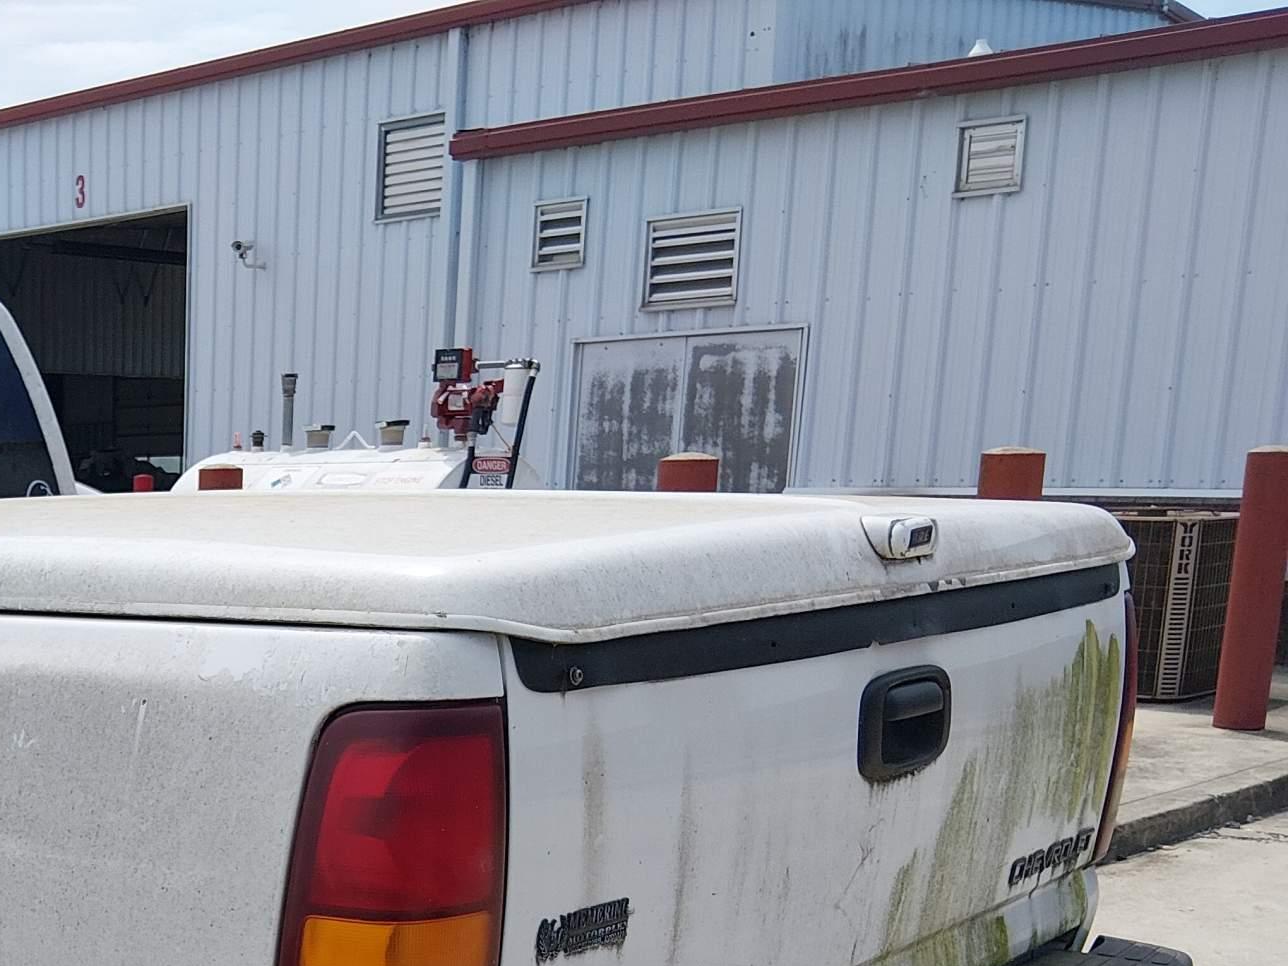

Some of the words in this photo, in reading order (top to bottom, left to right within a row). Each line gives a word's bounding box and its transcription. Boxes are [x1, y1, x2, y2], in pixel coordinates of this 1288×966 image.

[75, 175, 85, 209] 3
[476, 460, 507, 470] DANGER
[480, 475, 503, 486] DIESEL
[1176, 522, 1198, 575] YORK
[1008, 827, 1095, 886] CHEVROLET
